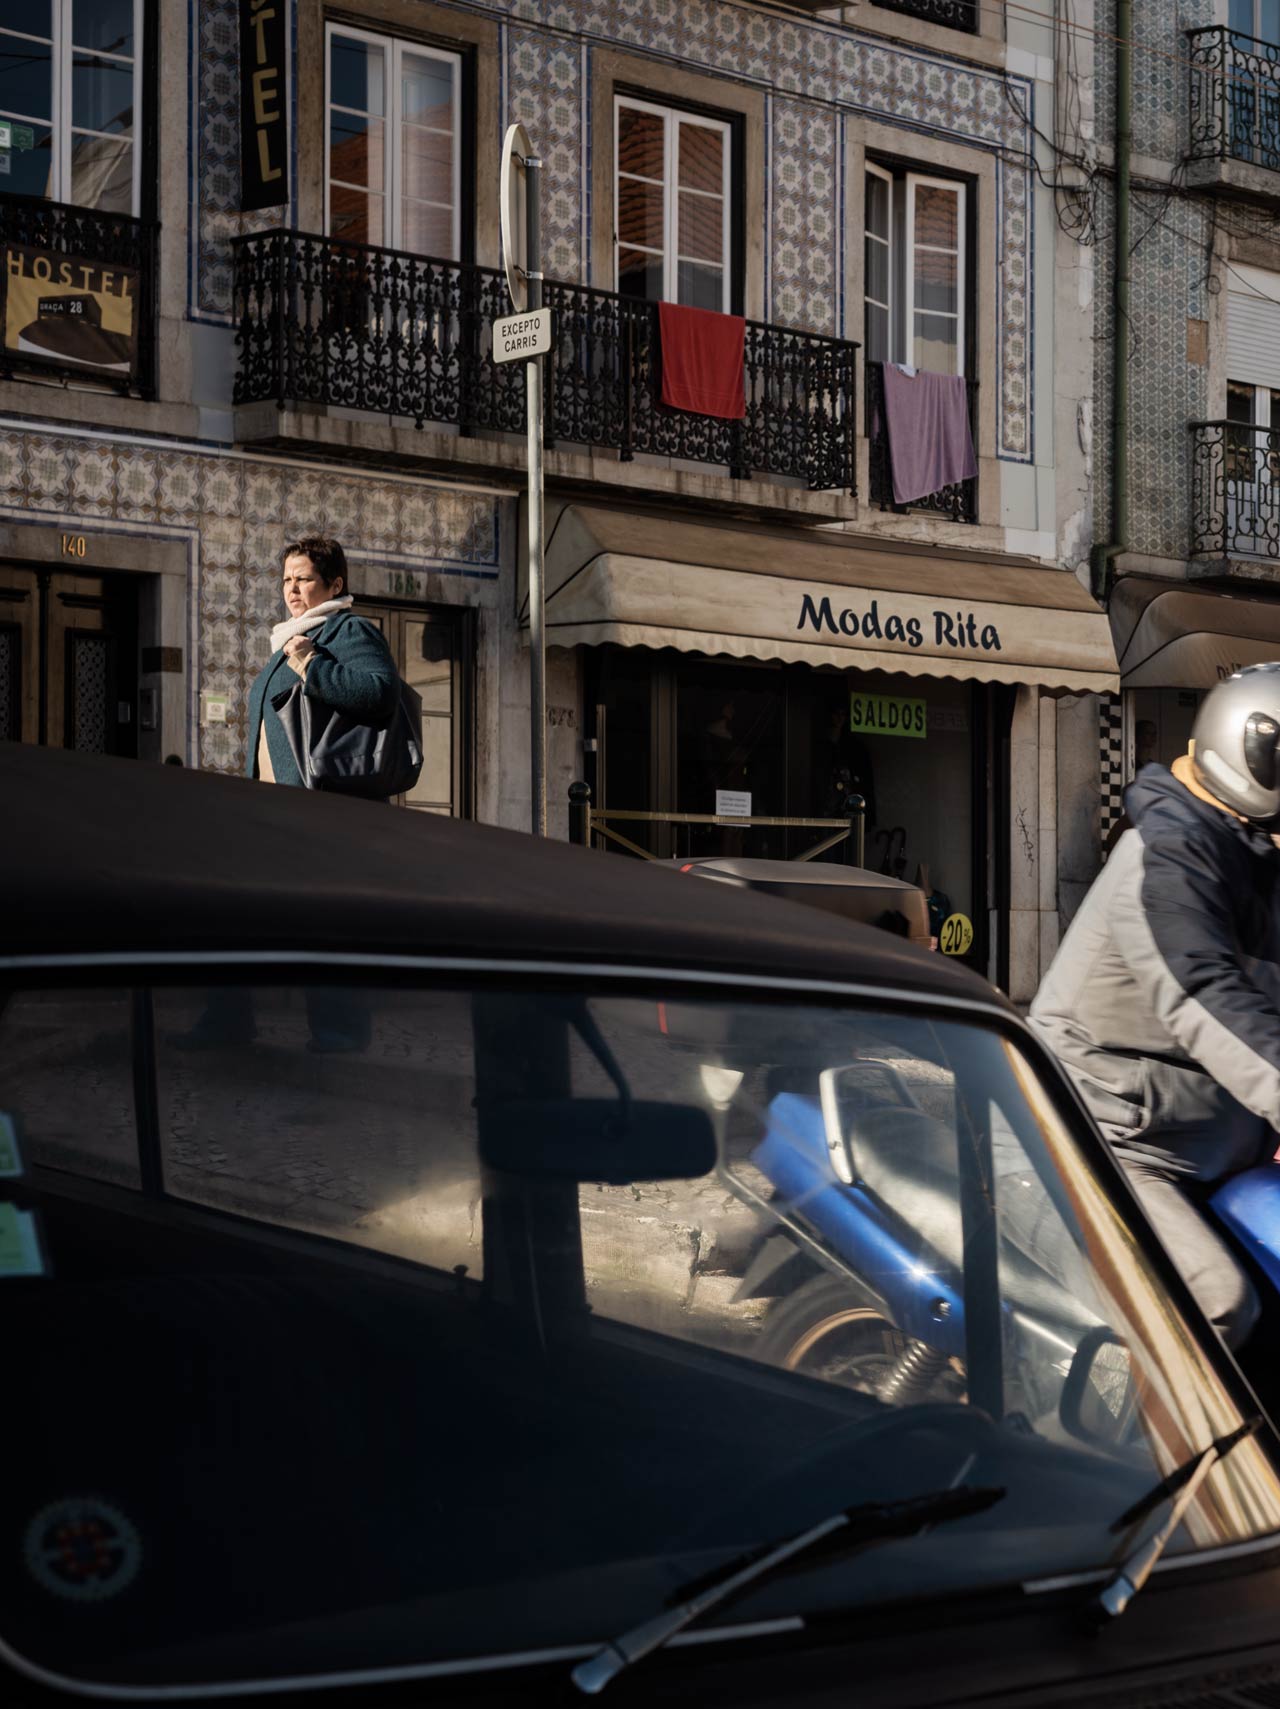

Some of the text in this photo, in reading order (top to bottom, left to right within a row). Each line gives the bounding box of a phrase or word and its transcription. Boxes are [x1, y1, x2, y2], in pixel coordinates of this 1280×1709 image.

[251, 0, 283, 182] TEL
[70, 301, 83, 313] 28
[502, 318, 541, 337] EXCEPTO
[504, 334, 537, 353] CARRIS
[62, 533, 86, 557] 140
[797, 593, 1002, 651] Modas Rita
[852, 698, 924, 732] SALDOS
